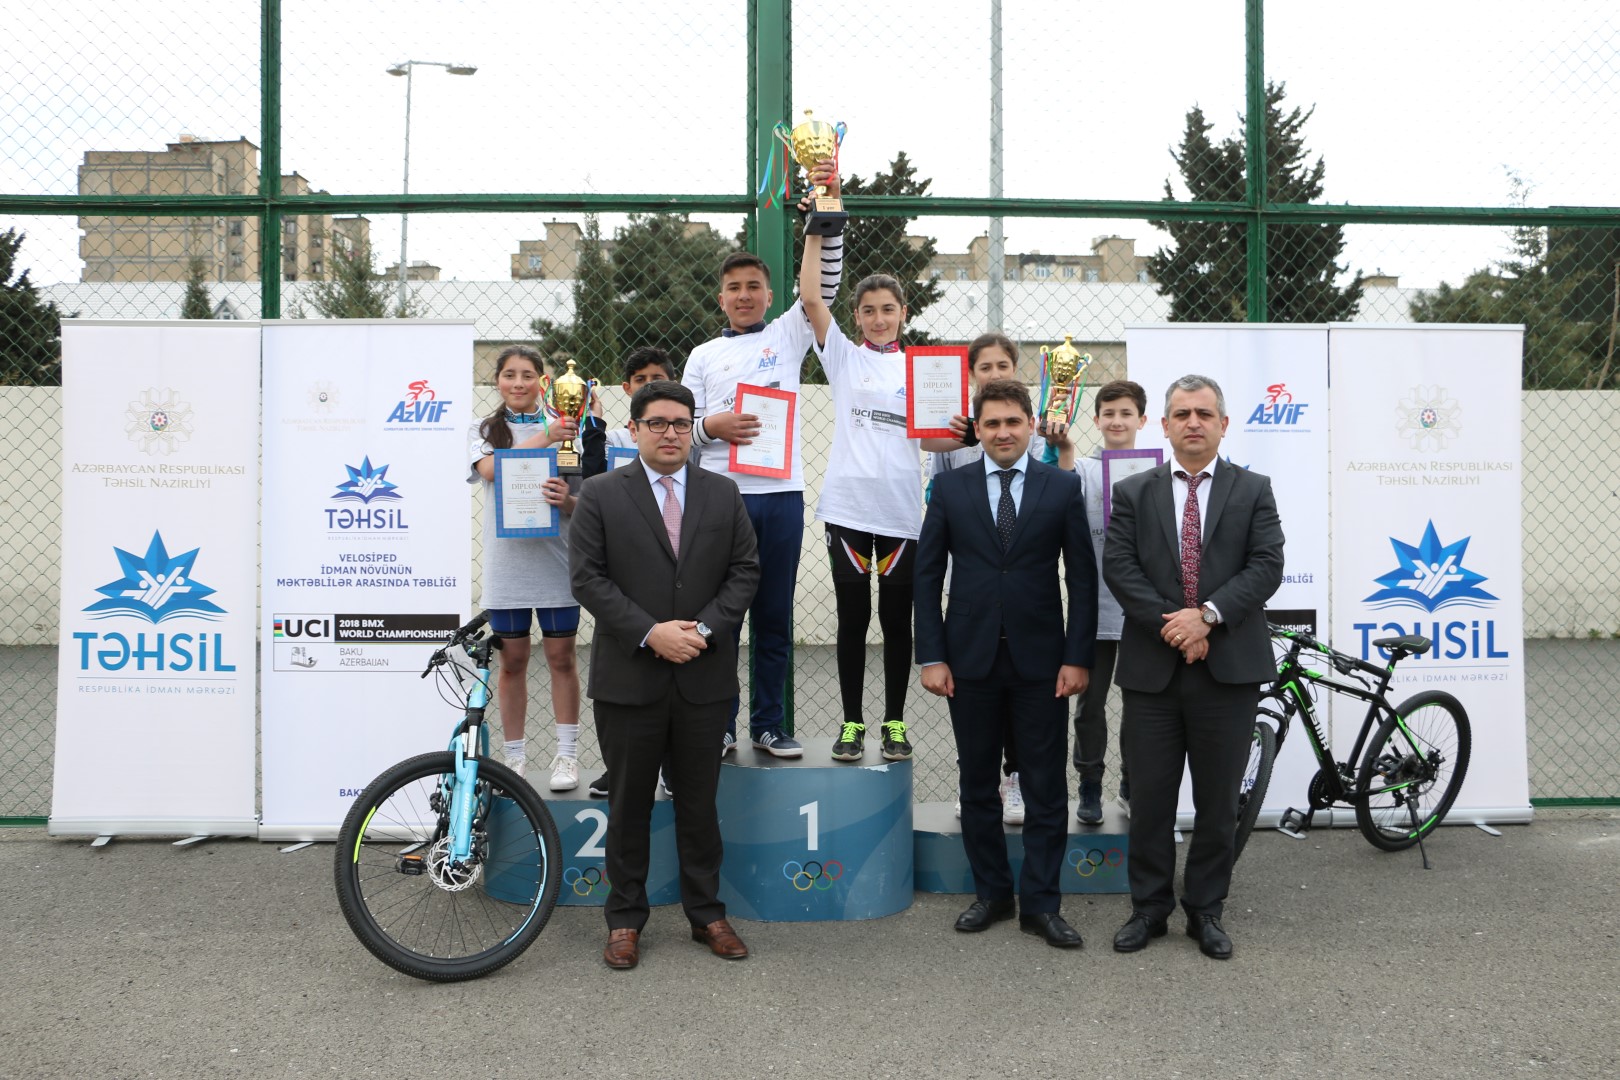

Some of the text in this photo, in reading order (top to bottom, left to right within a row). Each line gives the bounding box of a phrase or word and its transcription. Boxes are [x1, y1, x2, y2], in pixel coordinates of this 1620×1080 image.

[71, 463, 245, 475] AZƏRBAYCAN RESPUBLİKASI
[1346, 461, 1513, 472] AZƏRBAYCAN RESPUBLİKASI
[103, 477, 211, 489] TƏHSİL NAZİRLİYİ
[1377, 475, 1480, 486] TƏHSİL NAZİRLİYİ
[339, 552, 397, 563] VELOSİPED
[320, 564, 412, 575] İDMAN NÖVÜNÜN
[276, 577, 457, 587] MƏKTƏBLİLƏR ARASINDA TƏBLİĞİ
[1281, 573, 1314, 584] ƏBLİĞİ
[284, 619, 330, 638] UCI
[339, 619, 385, 628] 2018 BMX
[339, 630, 456, 638] WORLD CHAMPIONSHIPS
[339, 648, 363, 656] BAKU
[339, 658, 389, 667] AZERBAIJAN
[1422, 673, 1457, 683] İDMAN
[1461, 672, 1508, 682] MƏRKƏZİ
[78, 684, 141, 694] RESPUBLİKA
[146, 685, 181, 694] İDMAN
[339, 788, 366, 797] BAK
[799, 800, 819, 851] 1
[574, 808, 608, 858] 2
